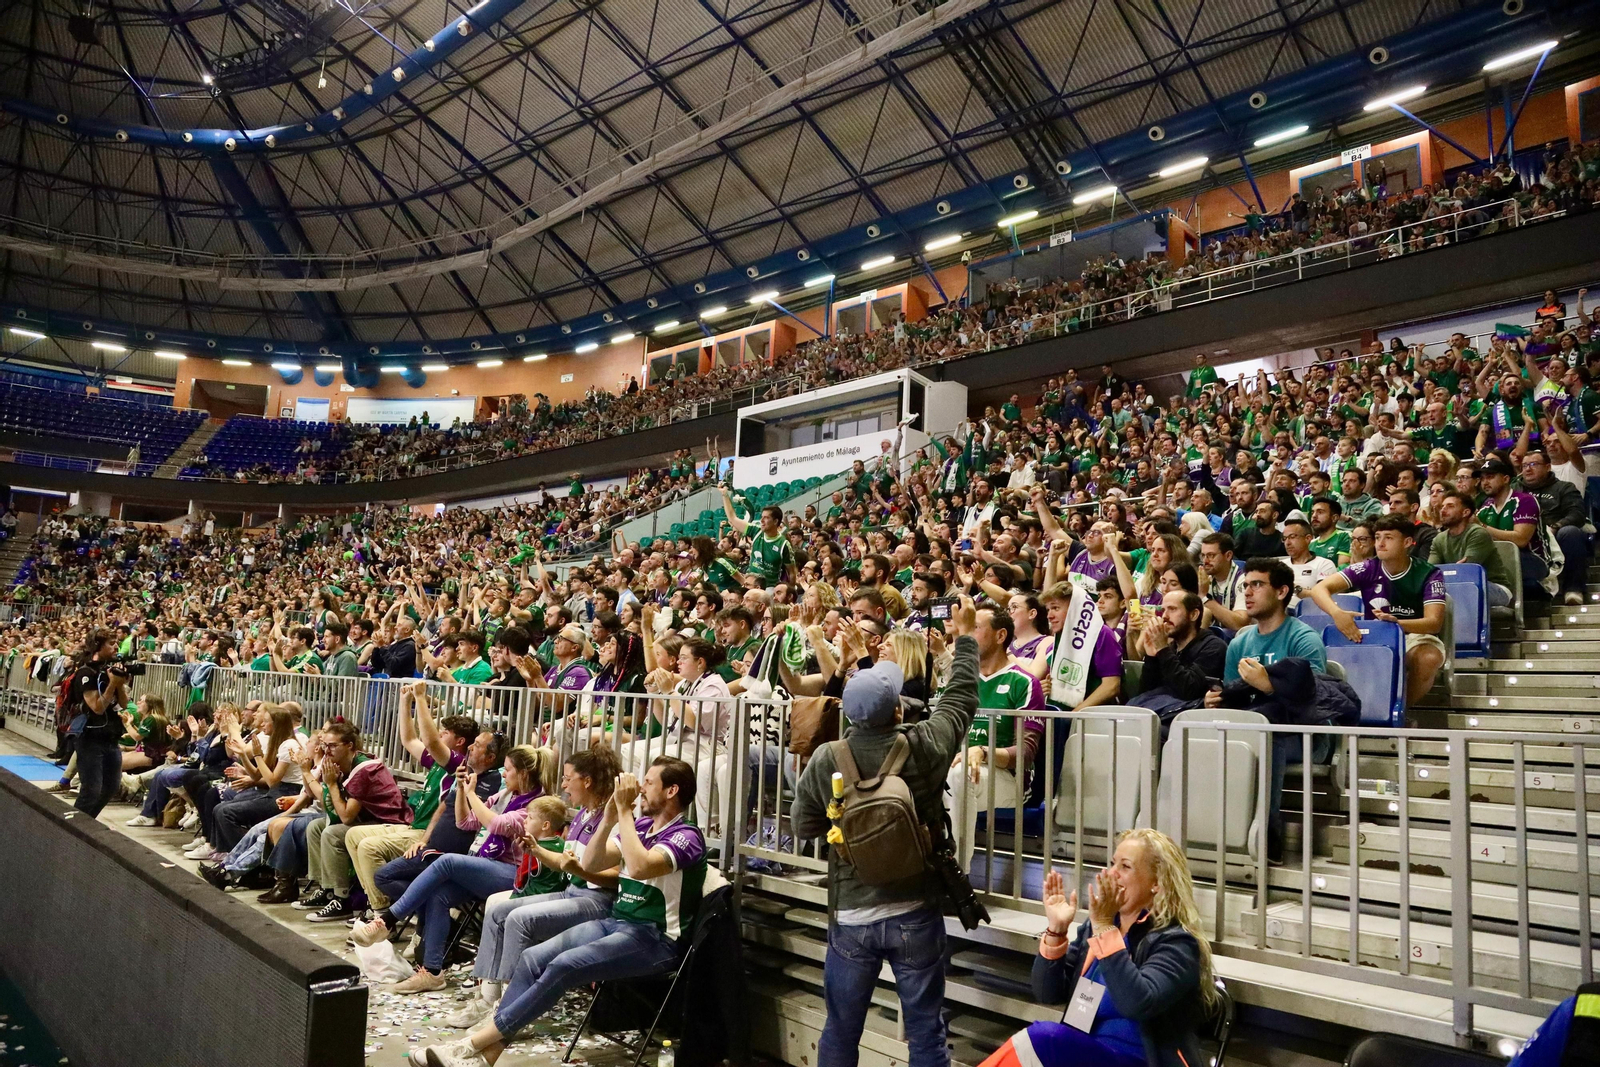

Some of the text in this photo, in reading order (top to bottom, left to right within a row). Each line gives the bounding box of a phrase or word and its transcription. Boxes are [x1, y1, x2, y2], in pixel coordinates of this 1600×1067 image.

[1343, 145, 1369, 157] SECTOR
[1351, 153, 1362, 161] B4
[1052, 231, 1070, 240] SECTOR
[781, 445, 861, 467] Ayuntamiento de Málaga
[1389, 605, 1415, 616] Unicaja
[1573, 721, 1581, 730] 6
[1533, 777, 1541, 786] 5
[1480, 847, 1489, 857] 4
[1412, 945, 1422, 958] 3
[1079, 992, 1095, 1004] Staff
